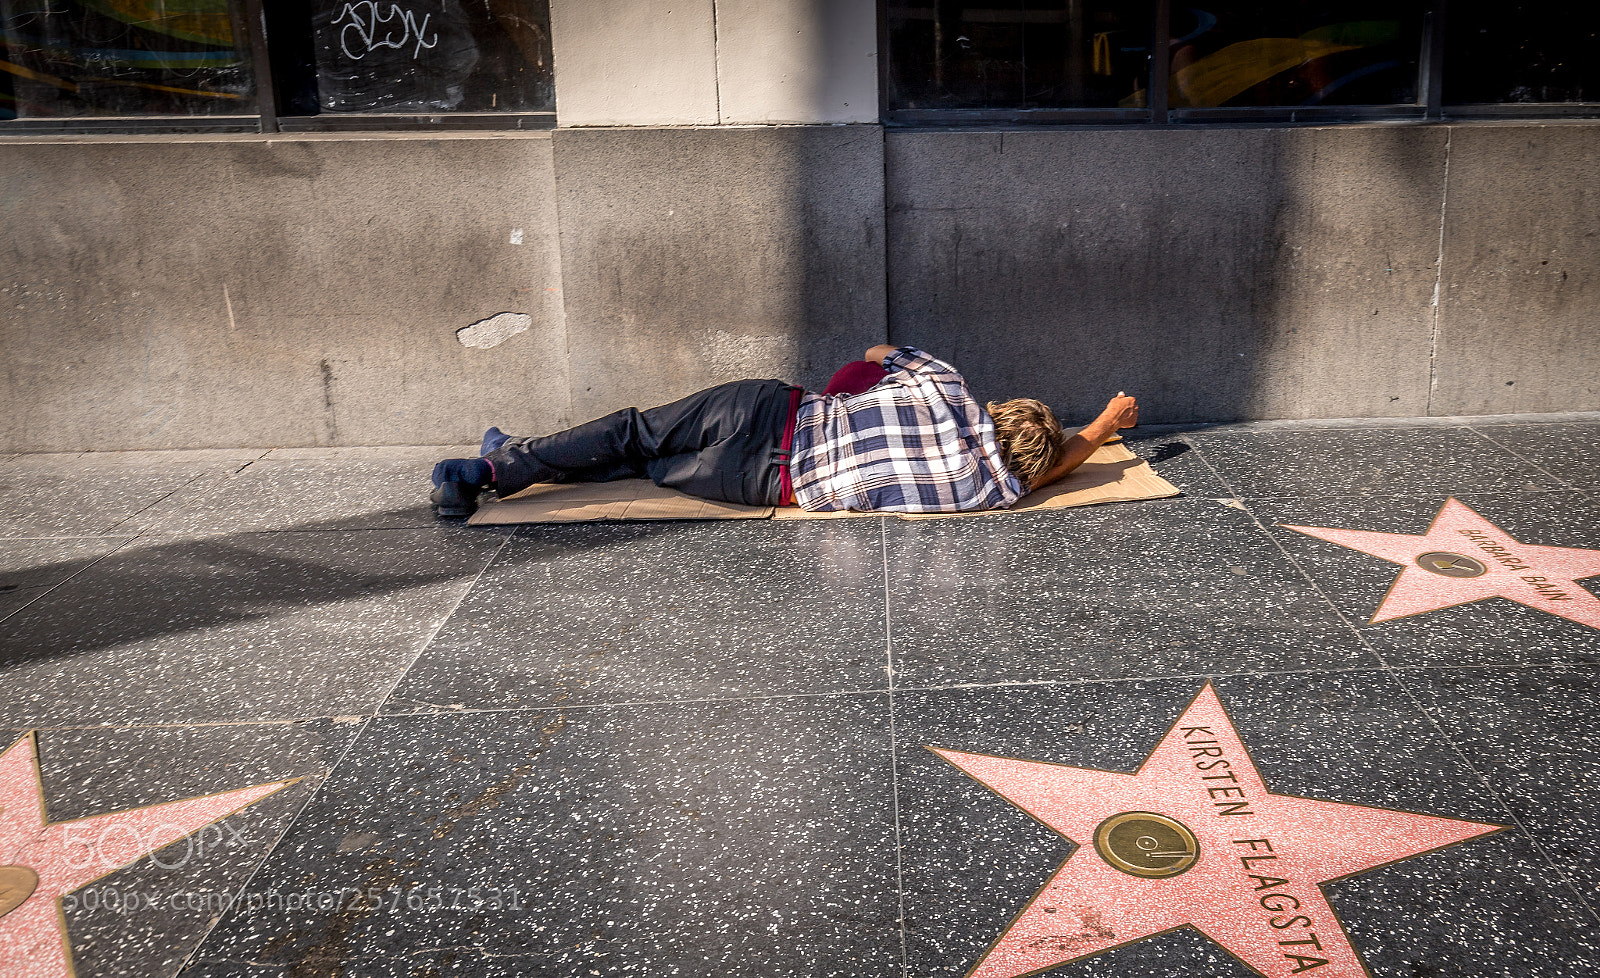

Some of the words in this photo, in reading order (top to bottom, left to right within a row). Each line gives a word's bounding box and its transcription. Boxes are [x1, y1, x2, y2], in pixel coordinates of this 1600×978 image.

[1457, 528, 1531, 571] BARBARA
[1520, 576, 1574, 601] BAIN
[1179, 725, 1254, 817] KIRSTEN
[1232, 838, 1330, 975] FLAGSTA
